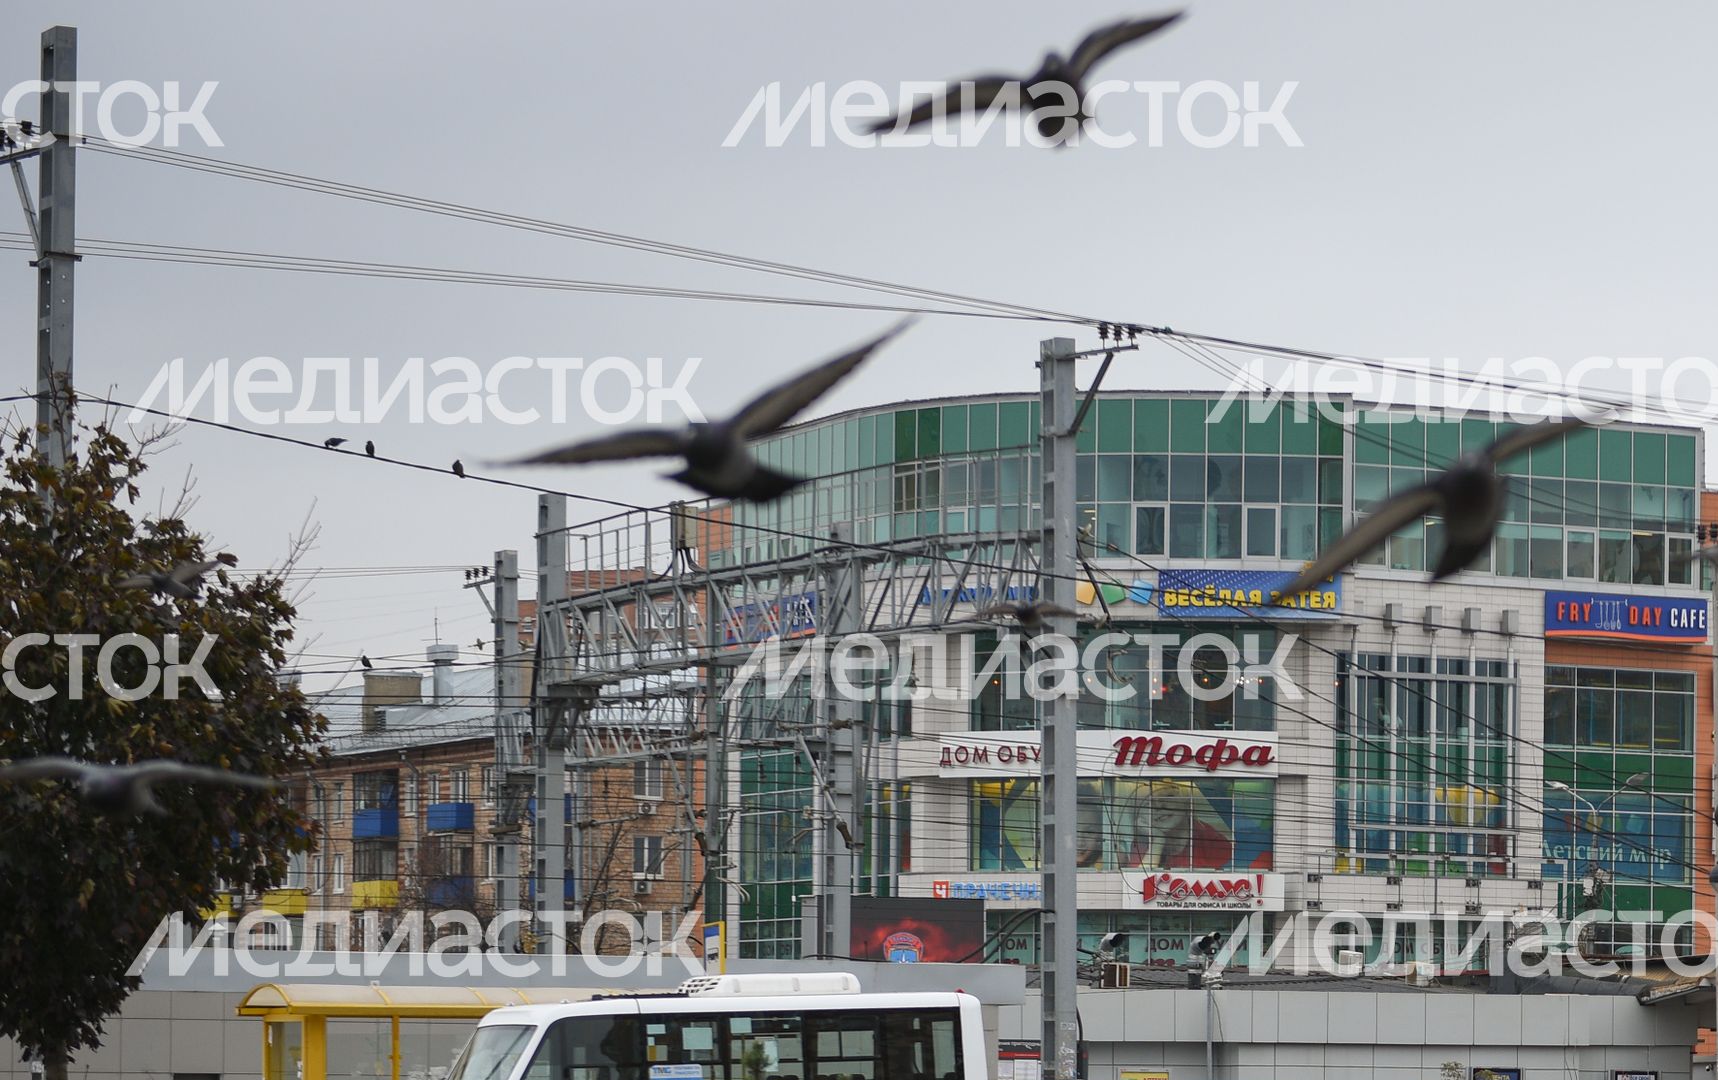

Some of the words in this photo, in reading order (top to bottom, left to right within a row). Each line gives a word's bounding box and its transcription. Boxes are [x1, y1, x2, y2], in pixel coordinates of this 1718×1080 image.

[1163, 584, 1263, 608] ВЕСЁЛАЯ
[1557, 601, 1591, 622] FRY
[1629, 605, 1662, 626] DAY
[1670, 608, 1706, 629] CAFE
[939, 745, 990, 767] ДОМ
[998, 745, 1041, 764] ОБУ
[1145, 938, 1184, 952] ДОМ
